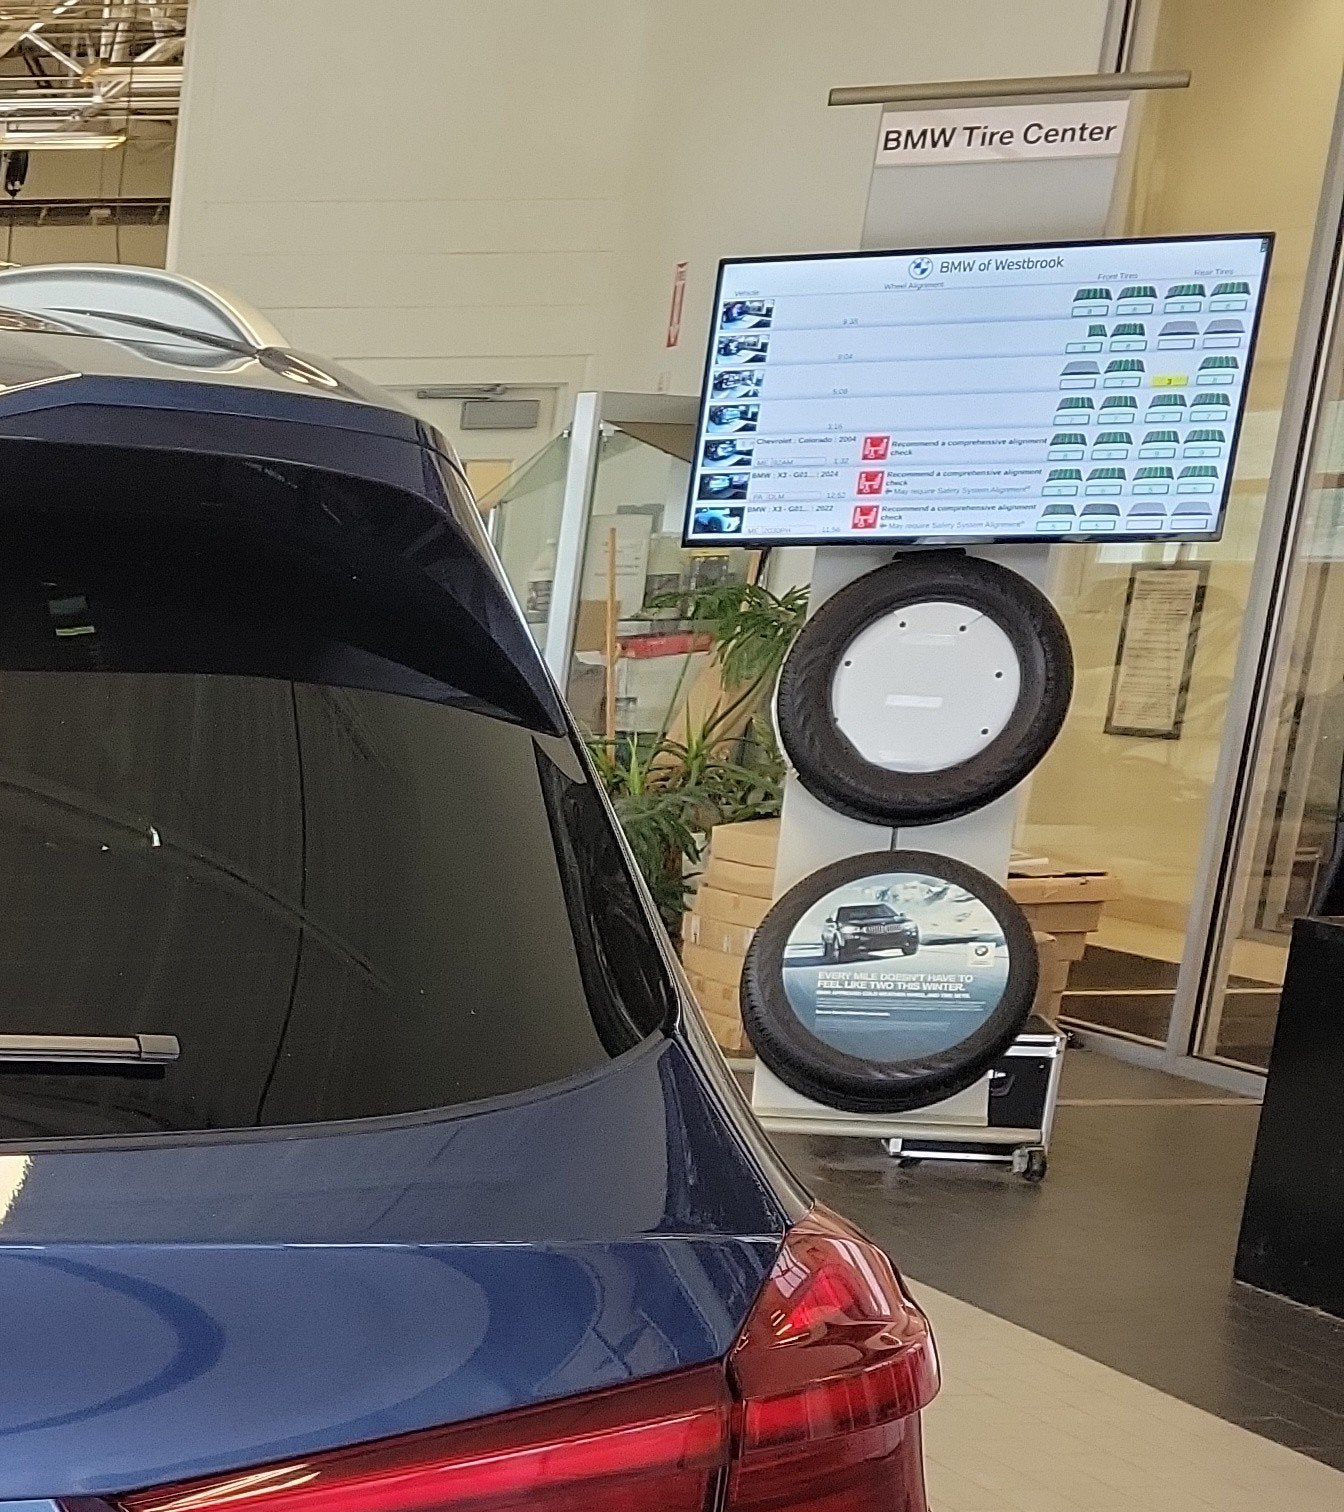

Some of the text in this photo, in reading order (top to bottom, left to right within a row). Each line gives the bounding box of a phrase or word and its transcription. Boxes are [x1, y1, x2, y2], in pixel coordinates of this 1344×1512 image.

[883, 122, 1118, 150] BMW Tire Center
[940, 260, 975, 273] BMW
[978, 259, 992, 272] of
[995, 256, 1064, 270] Westbrook
[947, 439, 1007, 447] comprehensive
[1008, 438, 1047, 446] alignment
[942, 469, 1001, 477] comprehensive
[1003, 468, 1042, 476] alignment
[937, 504, 996, 512] comprehensive
[818, 972, 973, 983] EVERY MILE DOESN'T HAVE TO
[844, 981, 868, 989] LIKE
[870, 982, 894, 990] TWO
[897, 982, 920, 990] THIS
[922, 983, 966, 991] WINTER.
